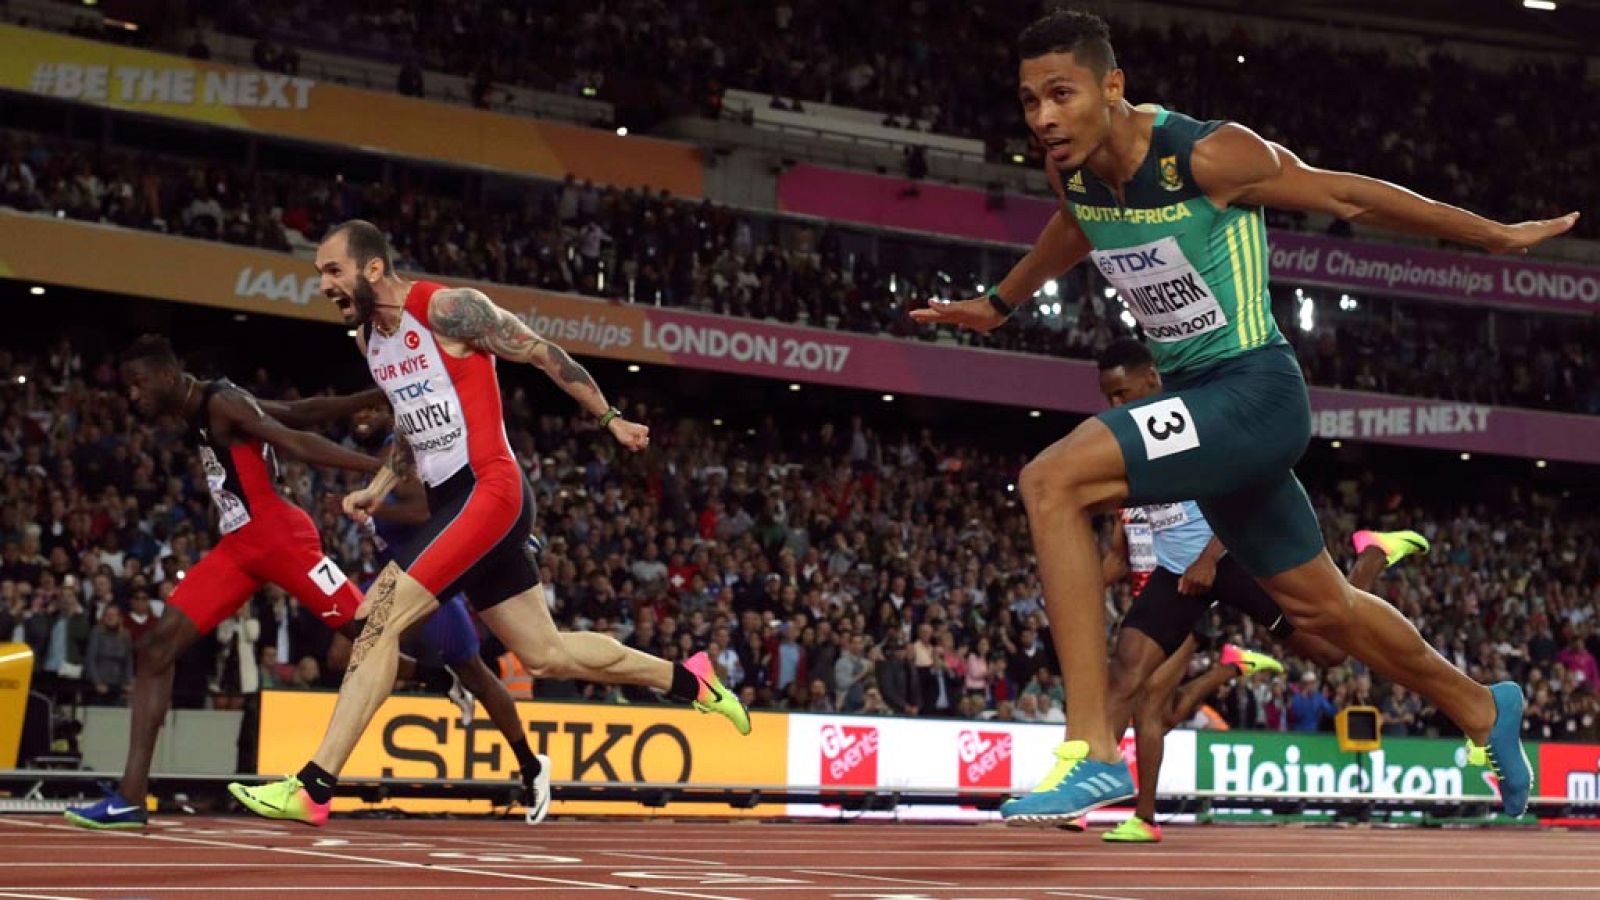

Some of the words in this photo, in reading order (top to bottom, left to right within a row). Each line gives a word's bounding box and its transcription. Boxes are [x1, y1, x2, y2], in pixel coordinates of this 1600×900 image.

[31, 62, 108, 99] #BE
[116, 66, 193, 104] THE
[203, 71, 315, 109] NEXT
[1111, 248, 1167, 273] TDK
[1324, 250, 1494, 294] Championships
[1130, 271, 1209, 316] NIEKERK
[1182, 309, 1217, 334] 2017
[642, 321, 779, 365] LONDON
[783, 338, 852, 374] 2017
[394, 379, 434, 401] TDK
[1146, 410, 1186, 441] 3
[1357, 406, 1412, 437] THE
[1415, 405, 1492, 435] NEXT
[317, 563, 337, 586] 7
[381, 713, 692, 784] SEIKO
[820, 724, 857, 759] GL
[829, 729, 882, 780] events
[958, 729, 992, 763] GL
[966, 735, 1013, 783] events
[1209, 743, 1464, 798] Heineken
